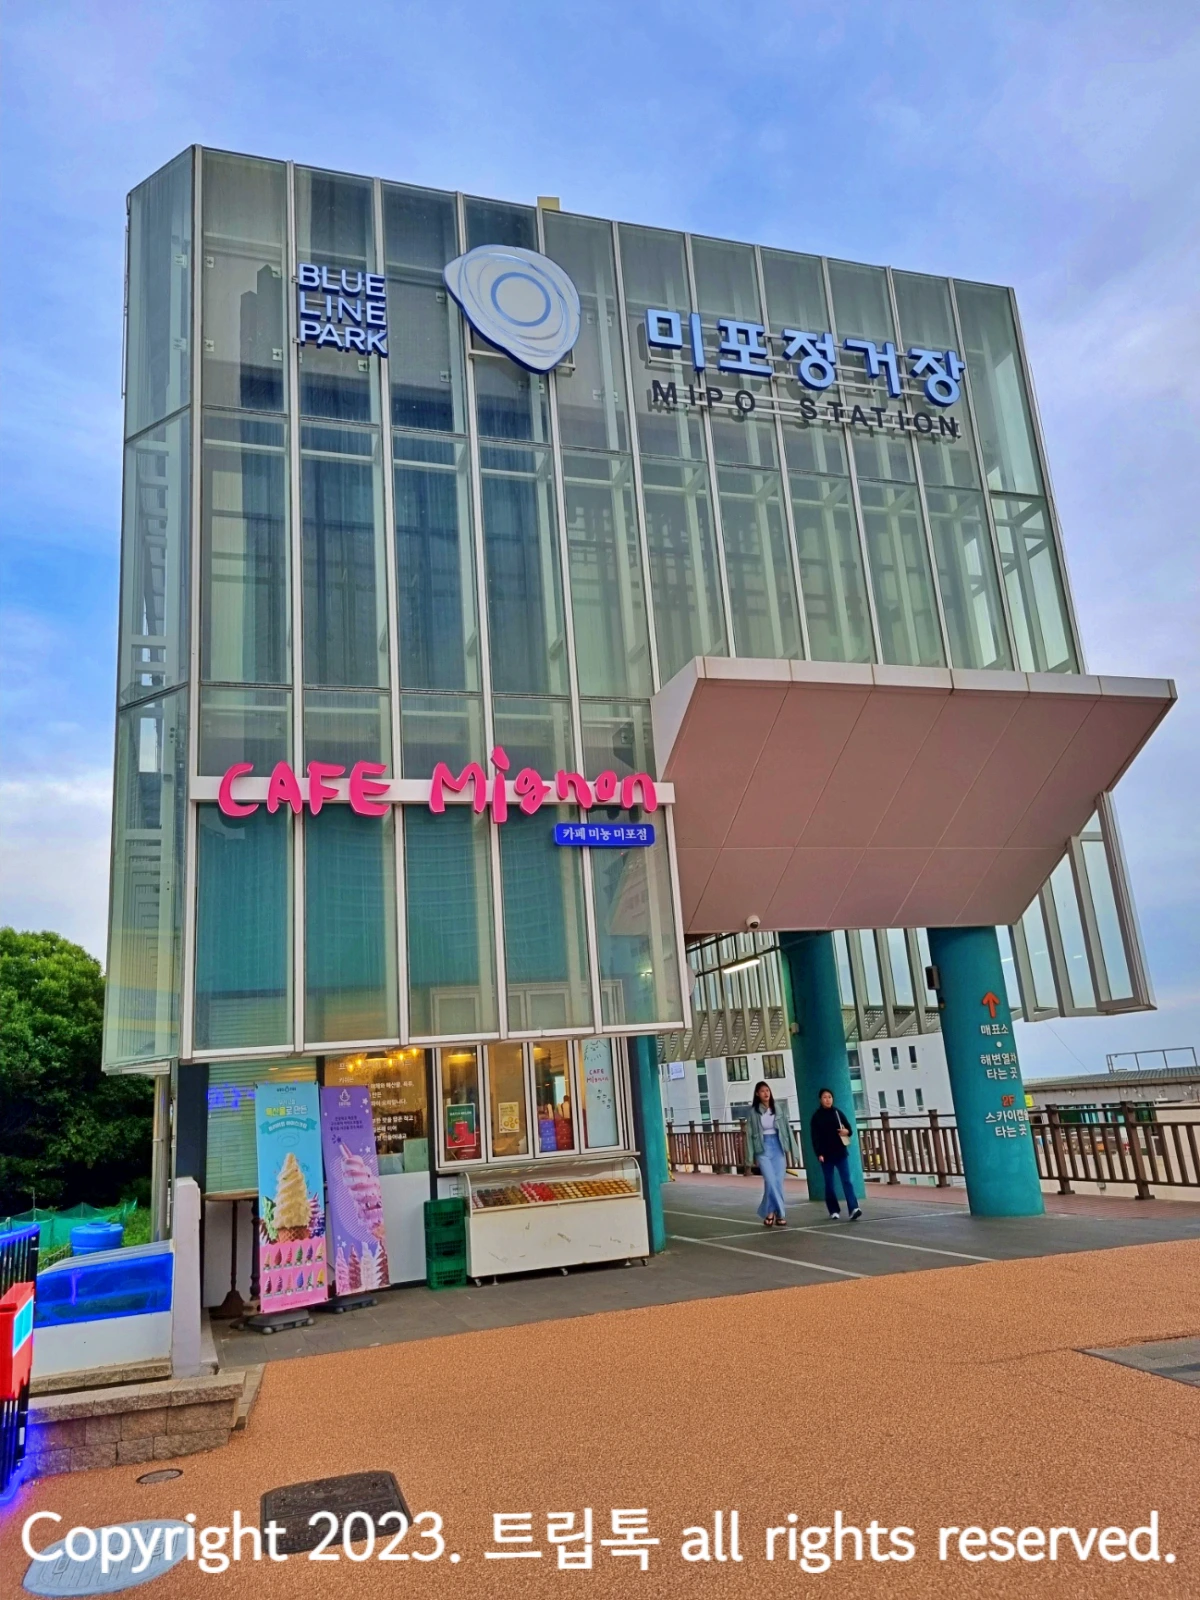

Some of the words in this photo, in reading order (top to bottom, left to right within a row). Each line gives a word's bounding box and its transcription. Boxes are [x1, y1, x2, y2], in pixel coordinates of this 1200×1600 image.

[299, 263, 386, 299] BLUE
[300, 291, 387, 328] LINE
[300, 320, 388, 358] PARK
[645, 308, 965, 407] 미포정거장
[652, 379, 756, 413] MIPO
[800, 397, 960, 438] STATION
[218, 760, 391, 817] CAFE
[428, 745, 658, 824] Mignon
[562, 827, 586, 841] 카페
[613, 827, 648, 841] 미포점
[980, 1024, 1009, 1036] 매표소
[980, 1052, 1017, 1066] 해변열차
[986, 1069, 1008, 1081] 타는
[1010, 1066, 1018, 1080] 곳
[1001, 1095, 1015, 1107] 2F
[995, 1126, 1017, 1139] 타는
[1018, 1124, 1027, 1136] 곳
